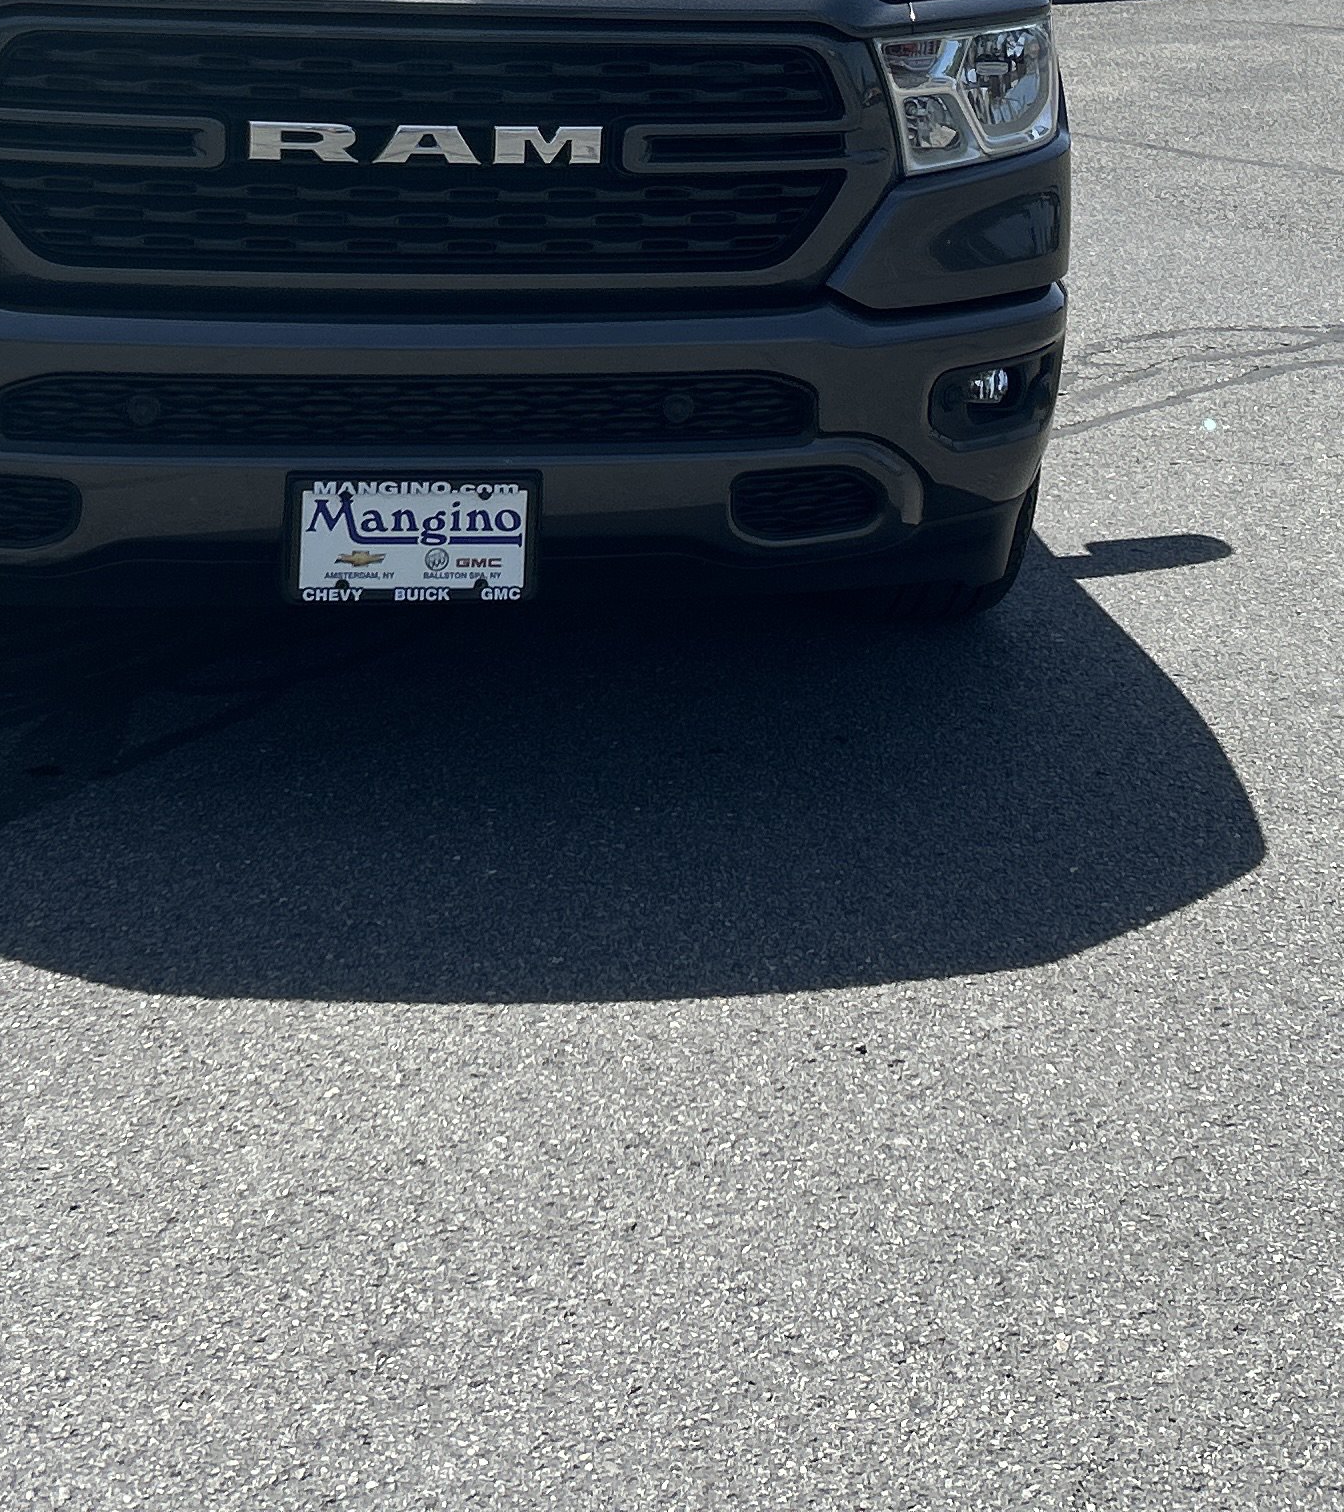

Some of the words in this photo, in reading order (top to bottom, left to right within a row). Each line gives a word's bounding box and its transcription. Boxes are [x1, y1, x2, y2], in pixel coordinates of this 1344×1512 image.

[248, 120, 604, 165] RAM
[306, 498, 522, 546] Mangino
[456, 557, 502, 568] GMC
[324, 571, 380, 580] AMSTERDAM,
[382, 571, 395, 580] NY
[423, 571, 468, 580] BALLSTON
[489, 571, 502, 580] NY
[302, 588, 364, 601] CHEVY
[394, 588, 451, 601] BUICK
[481, 588, 522, 601] GMC
